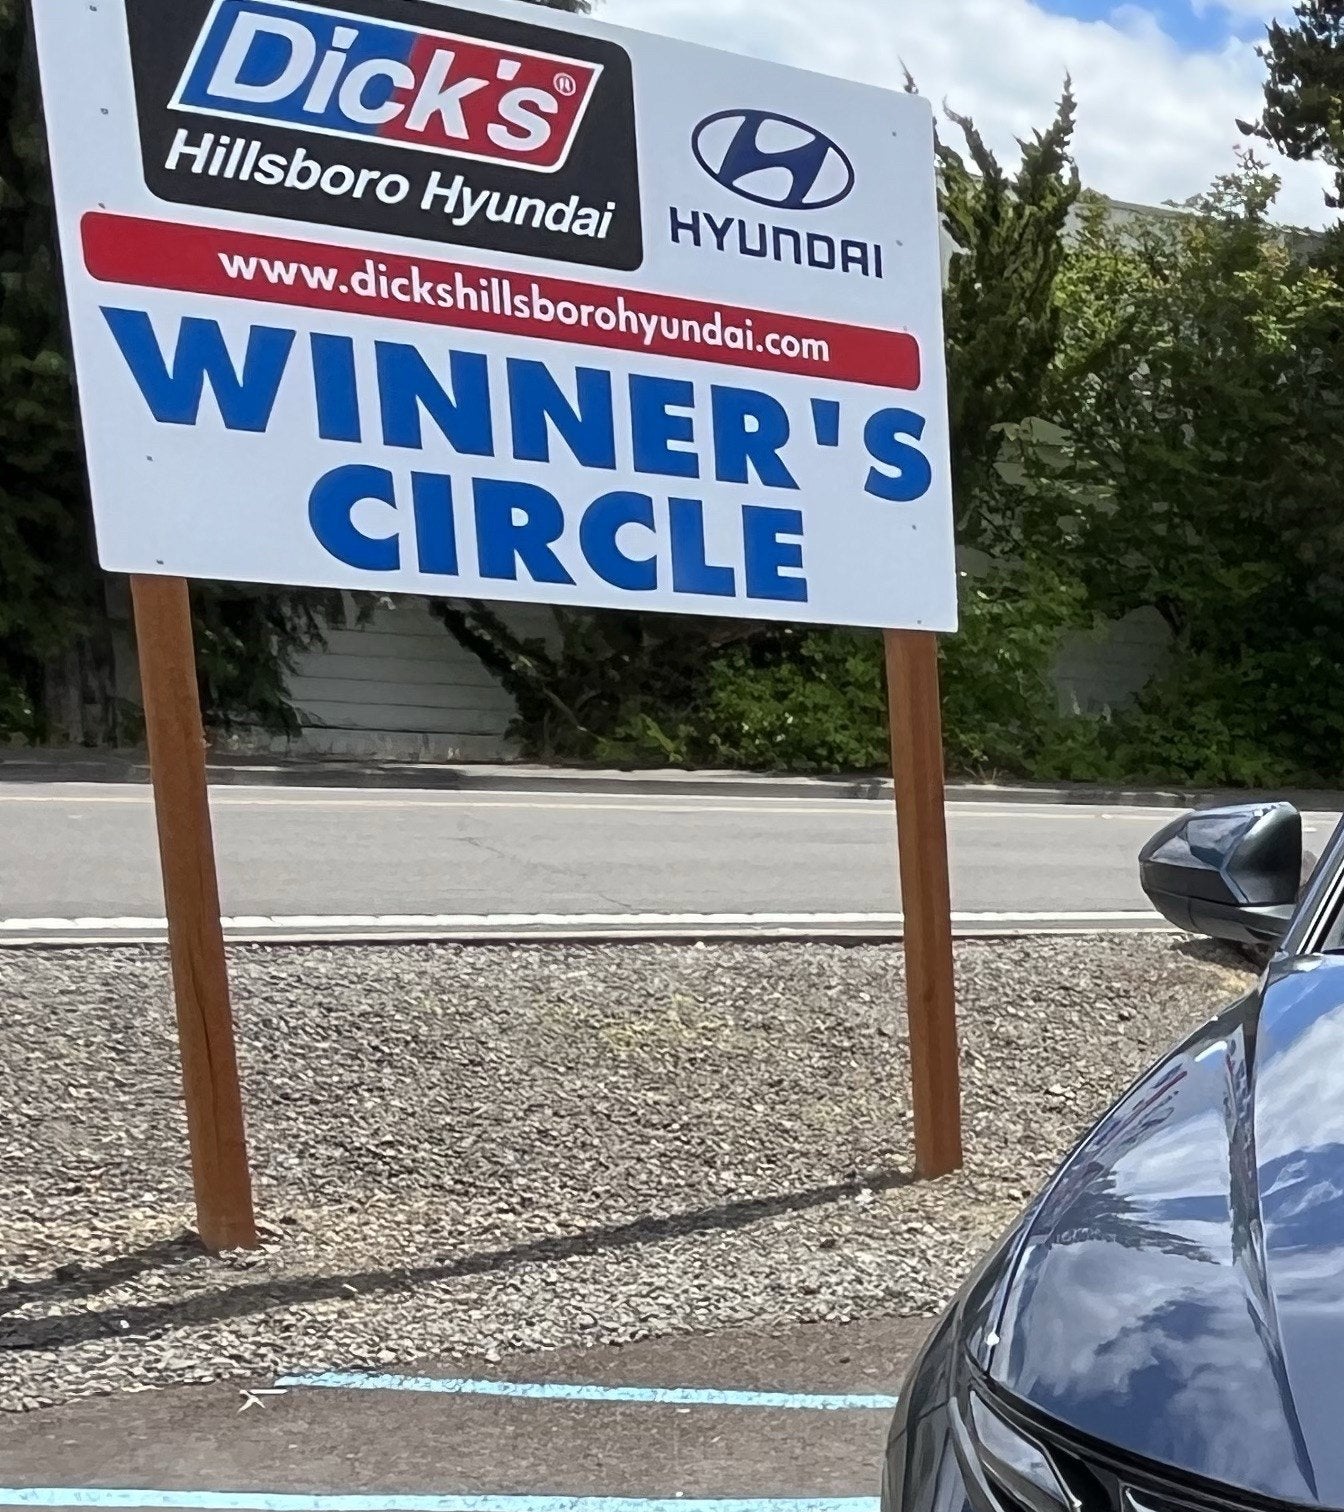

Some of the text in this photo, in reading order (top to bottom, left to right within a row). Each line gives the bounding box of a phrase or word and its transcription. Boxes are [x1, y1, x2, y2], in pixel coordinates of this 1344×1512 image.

[165, 129, 617, 239] Hillsboro Hyundai
[671, 207, 882, 279] HYUNDAI
[218, 249, 830, 364] www.dickshillsborohyundai.com
[100, 307, 932, 502] WINNER'S
[308, 464, 808, 602] CIRCLE
